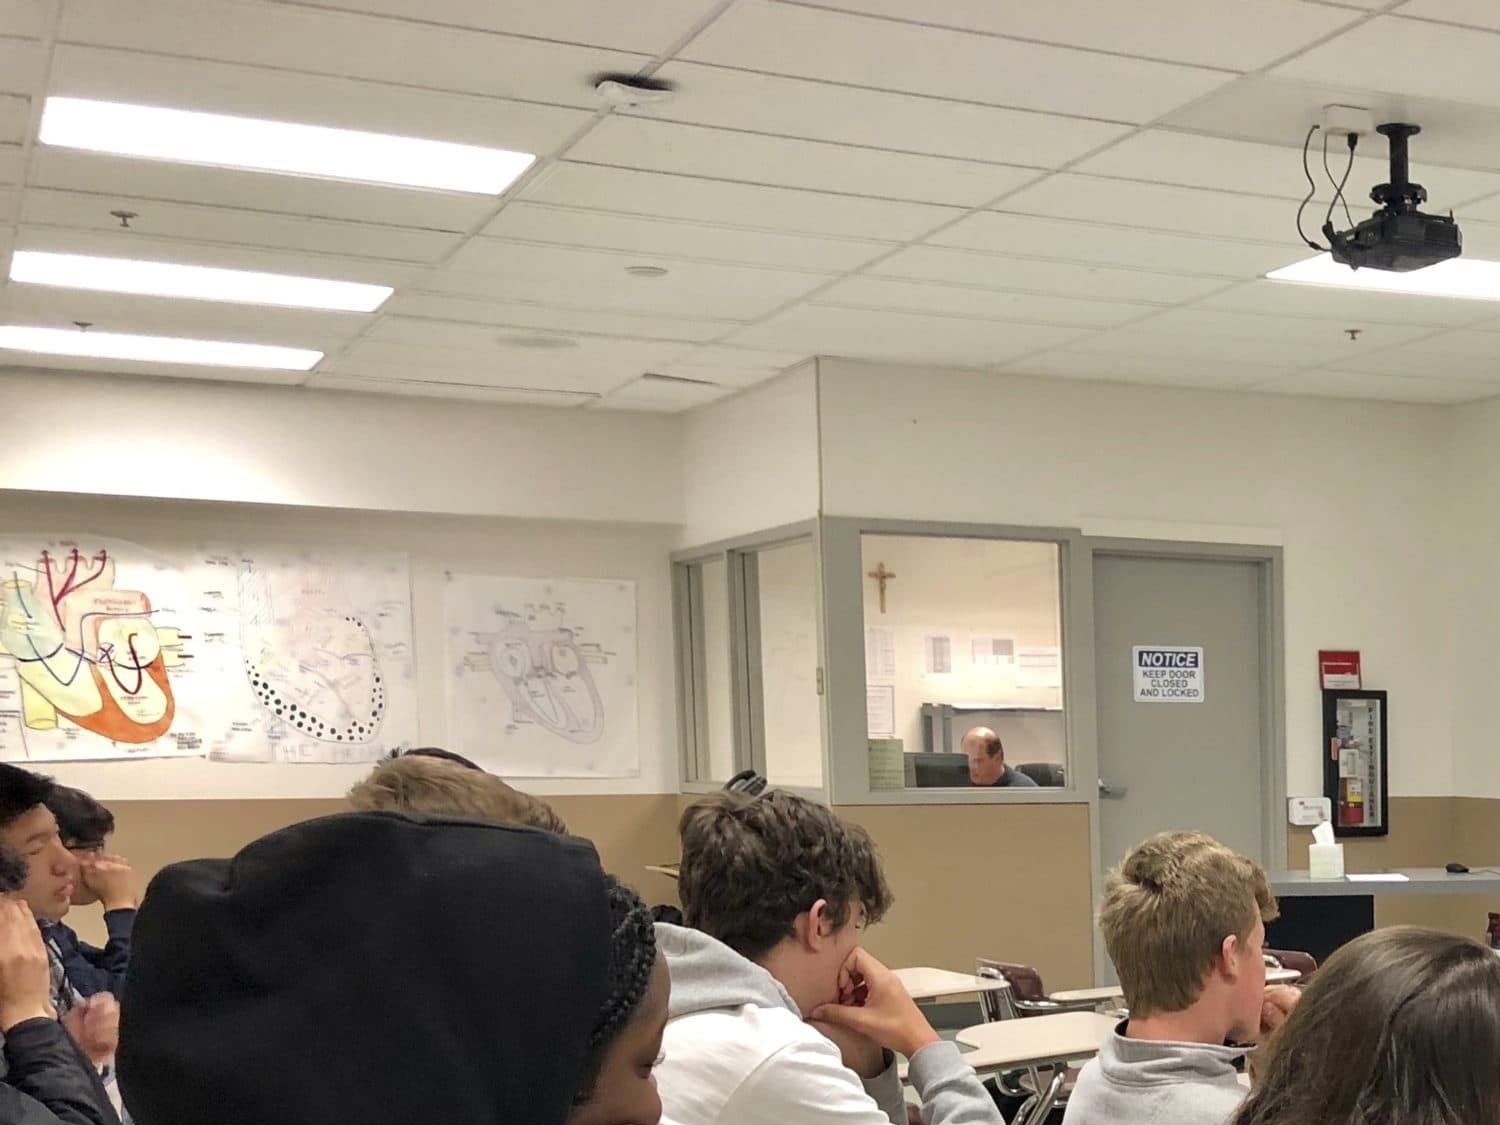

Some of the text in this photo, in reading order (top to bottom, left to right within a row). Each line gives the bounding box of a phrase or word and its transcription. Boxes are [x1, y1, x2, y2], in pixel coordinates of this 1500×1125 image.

[1141, 652, 1197, 667] NOTICE
[1142, 670, 1196, 679] KEEP DOOR
[1151, 679, 1188, 688] CLOSED
[1140, 688, 1199, 697] AND LOCKED
